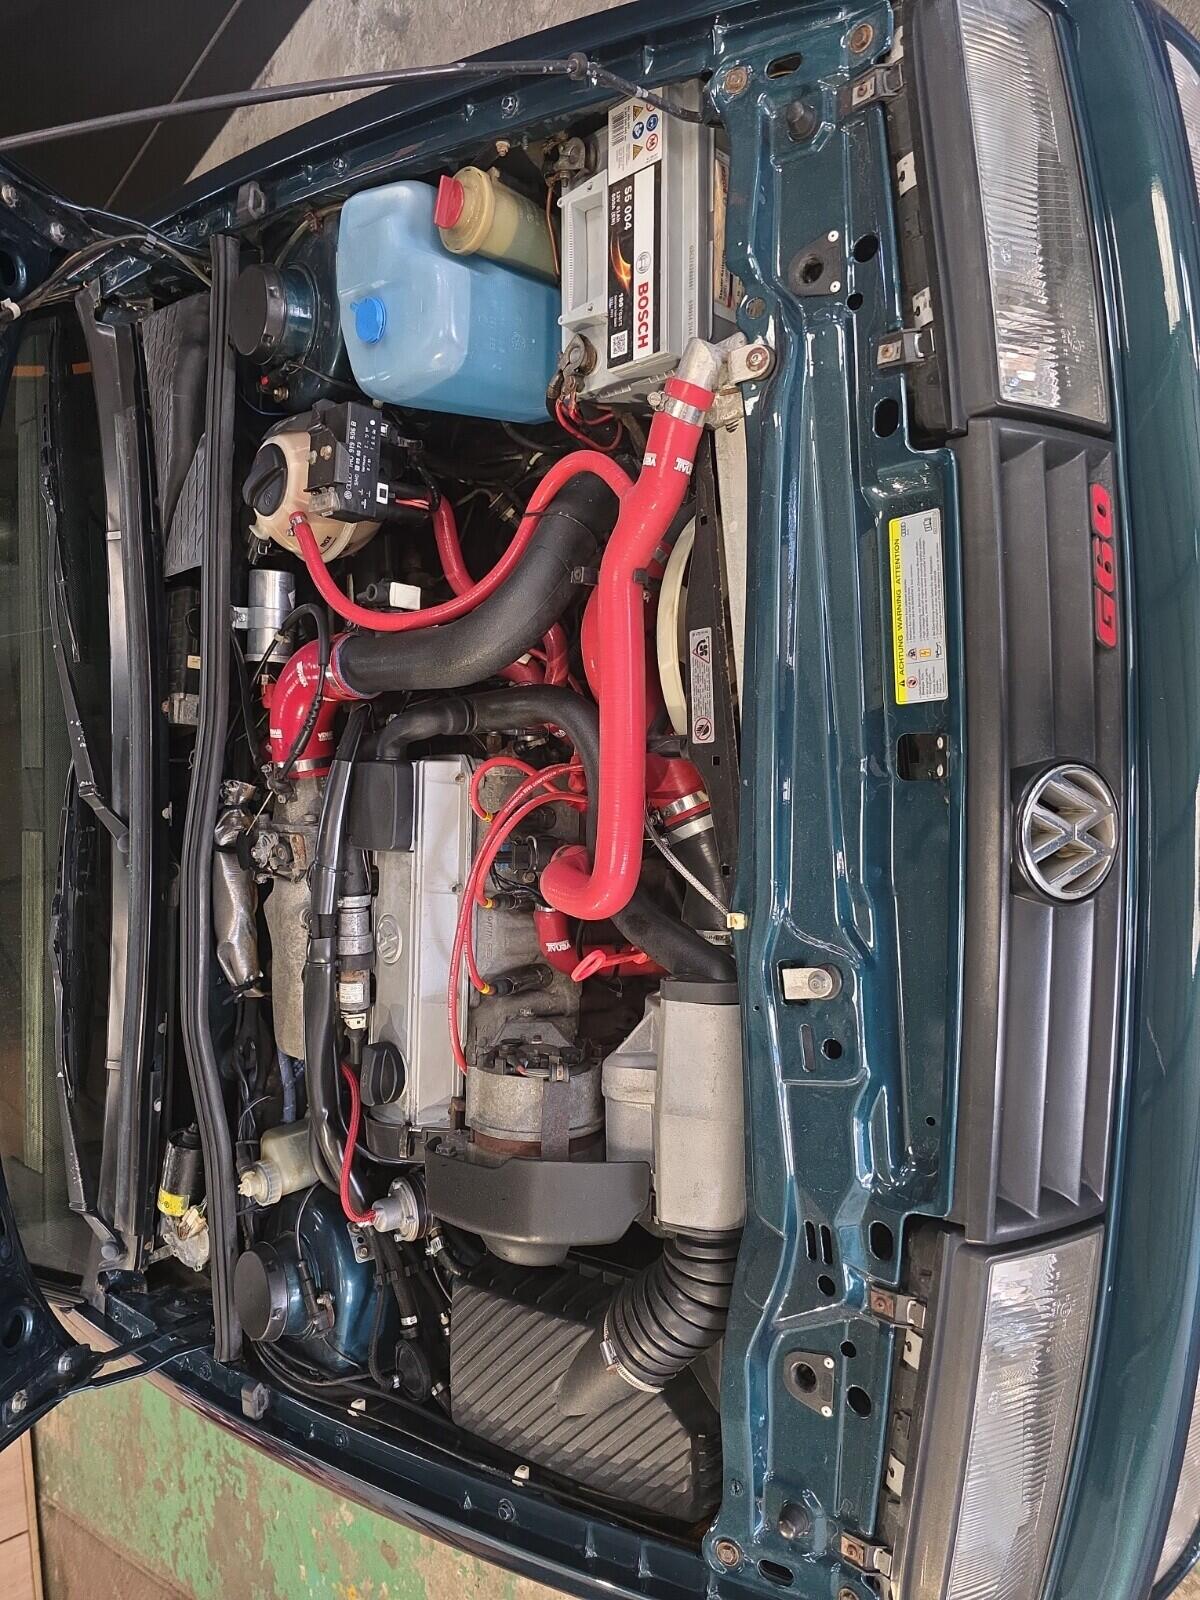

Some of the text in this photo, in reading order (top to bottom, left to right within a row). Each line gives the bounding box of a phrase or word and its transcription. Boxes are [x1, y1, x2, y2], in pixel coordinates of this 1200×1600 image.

[624, 185, 632, 231] S5 004
[637, 281, 649, 349] BOSCH
[893, 538, 904, 677] ACHTUNG WARNING ATTENTION
[1089, 482, 1119, 648] G60
